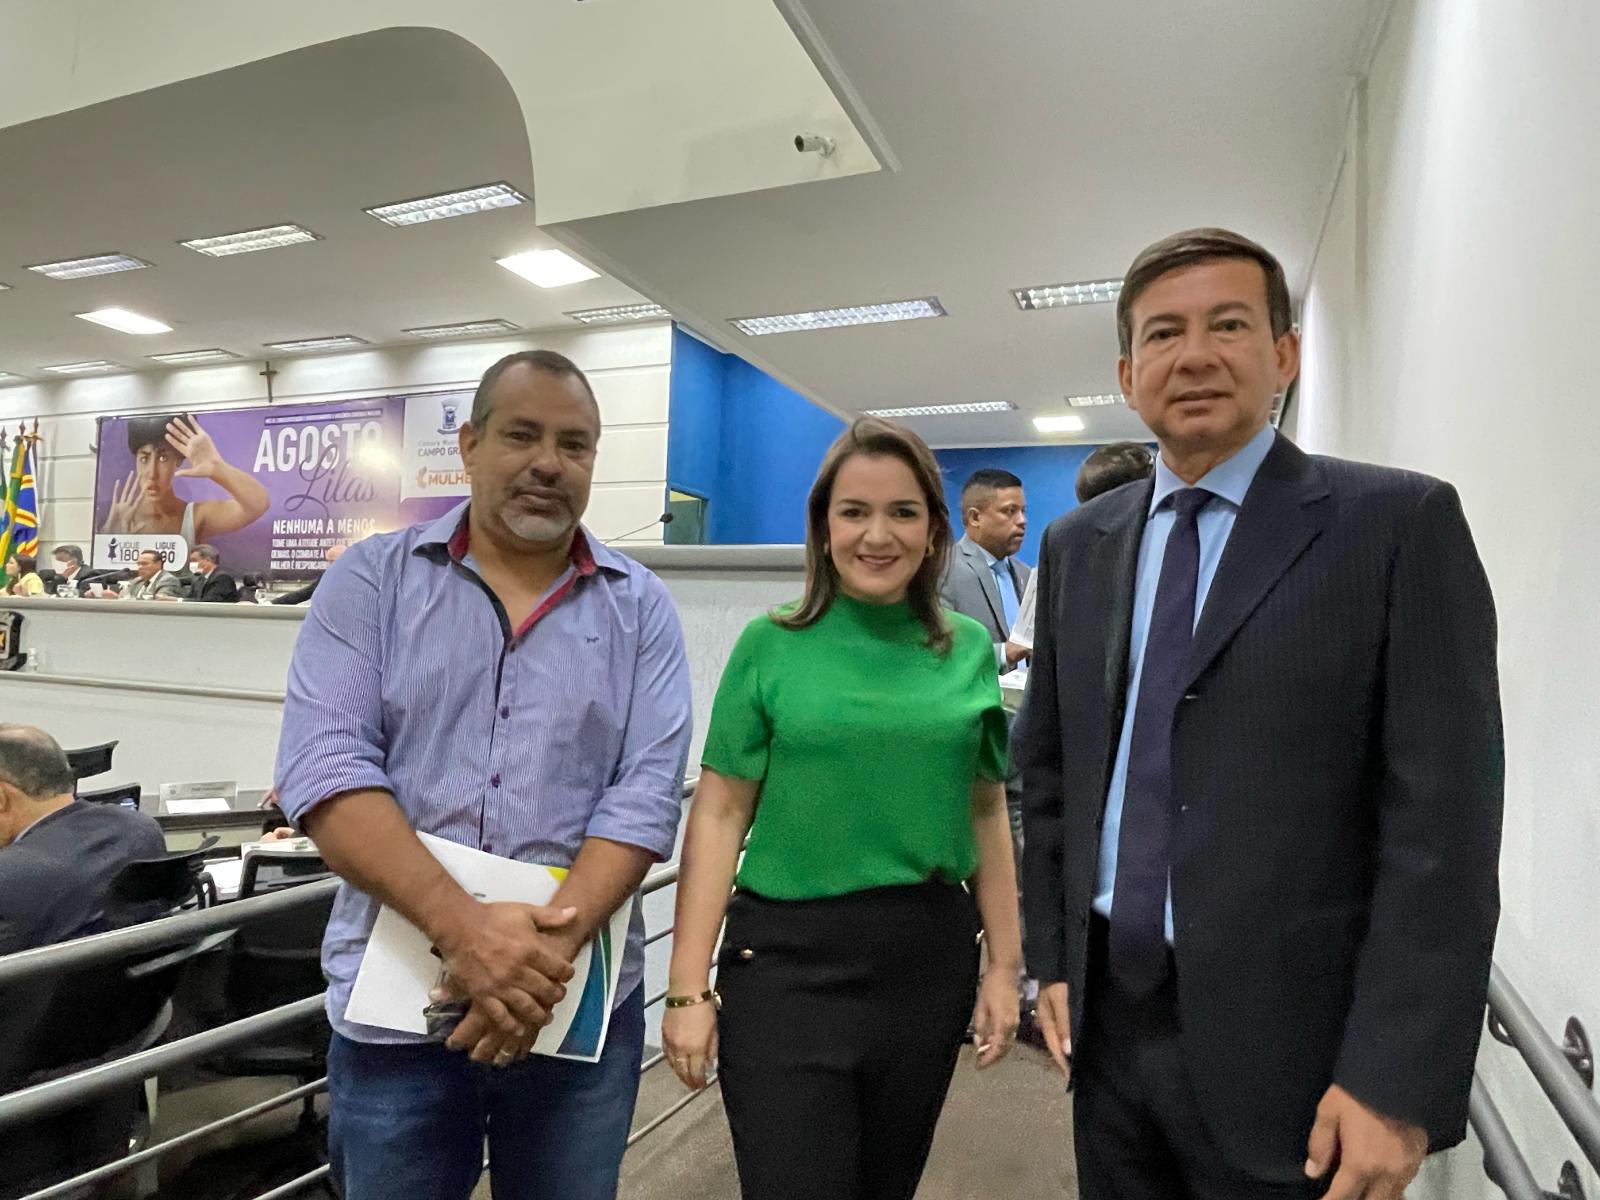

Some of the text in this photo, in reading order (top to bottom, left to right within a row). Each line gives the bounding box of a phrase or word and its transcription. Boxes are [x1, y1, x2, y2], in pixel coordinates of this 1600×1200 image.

[253, 421, 382, 473] AGOSTO
[418, 446, 461, 457] CAMPO GR
[428, 472, 472, 486] MULHE
[272, 517, 376, 535] NENHUMA A MENOS
[119, 541, 140, 550] LIGUE
[155, 541, 176, 550] LIGUE
[119, 549, 140, 562] 180
[158, 550, 176, 564] 90
